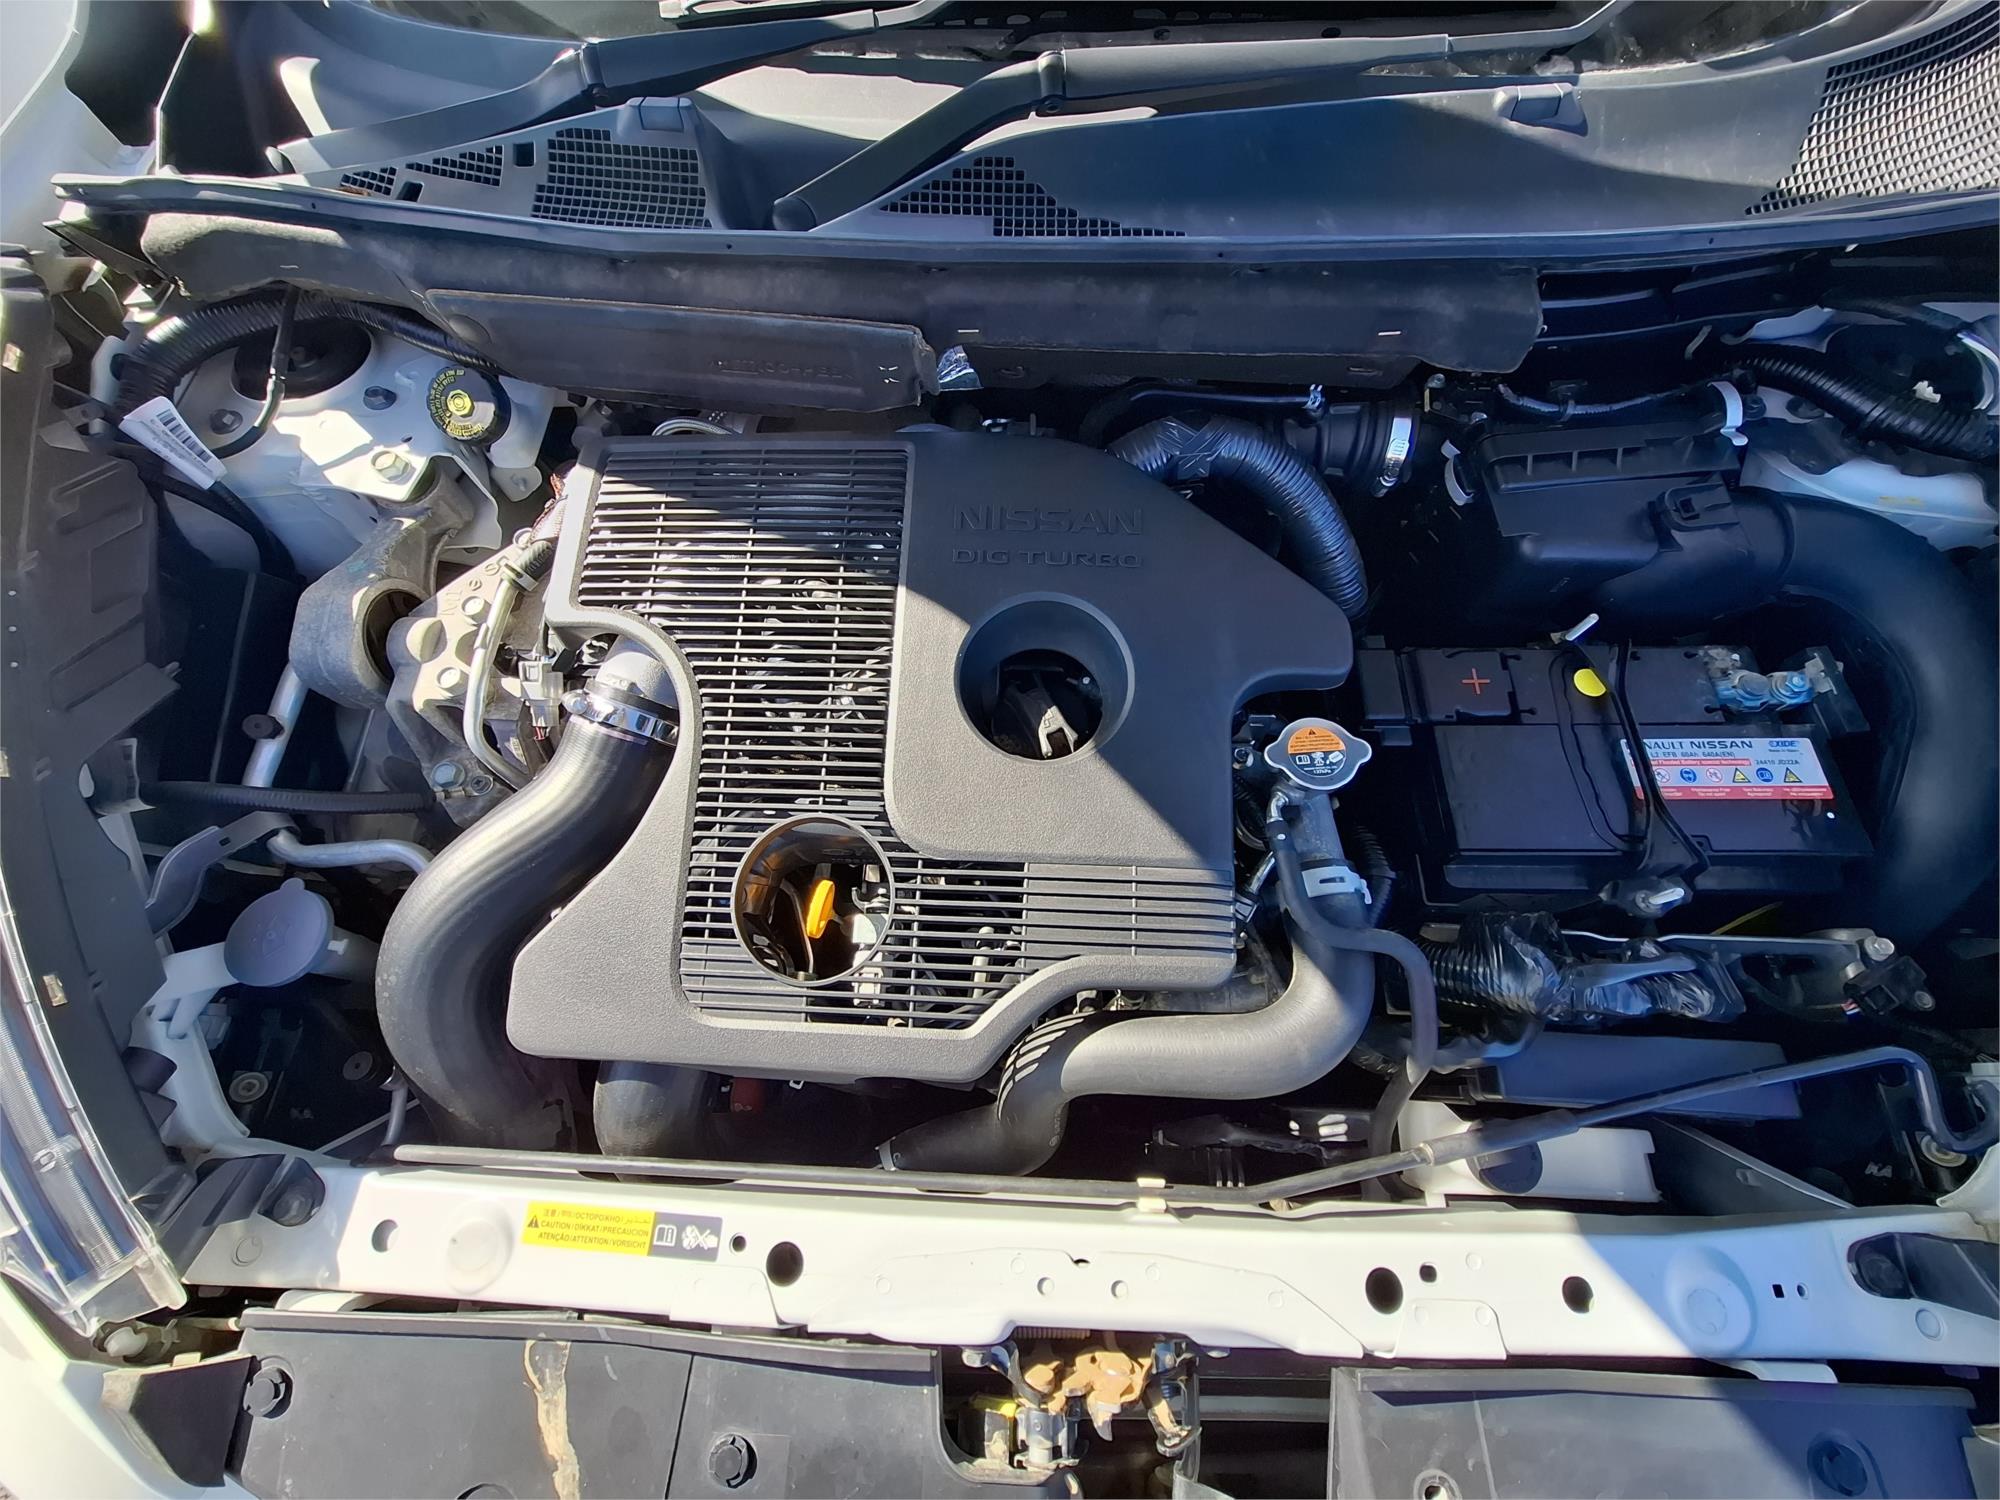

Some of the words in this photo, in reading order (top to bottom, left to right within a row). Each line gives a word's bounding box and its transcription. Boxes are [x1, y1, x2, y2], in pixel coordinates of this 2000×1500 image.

[952, 503, 1144, 536] NISSAN
[952, 549, 1010, 565] DIG
[1019, 551, 1143, 568] TURBO
[1690, 740, 1754, 749] NISSAN
